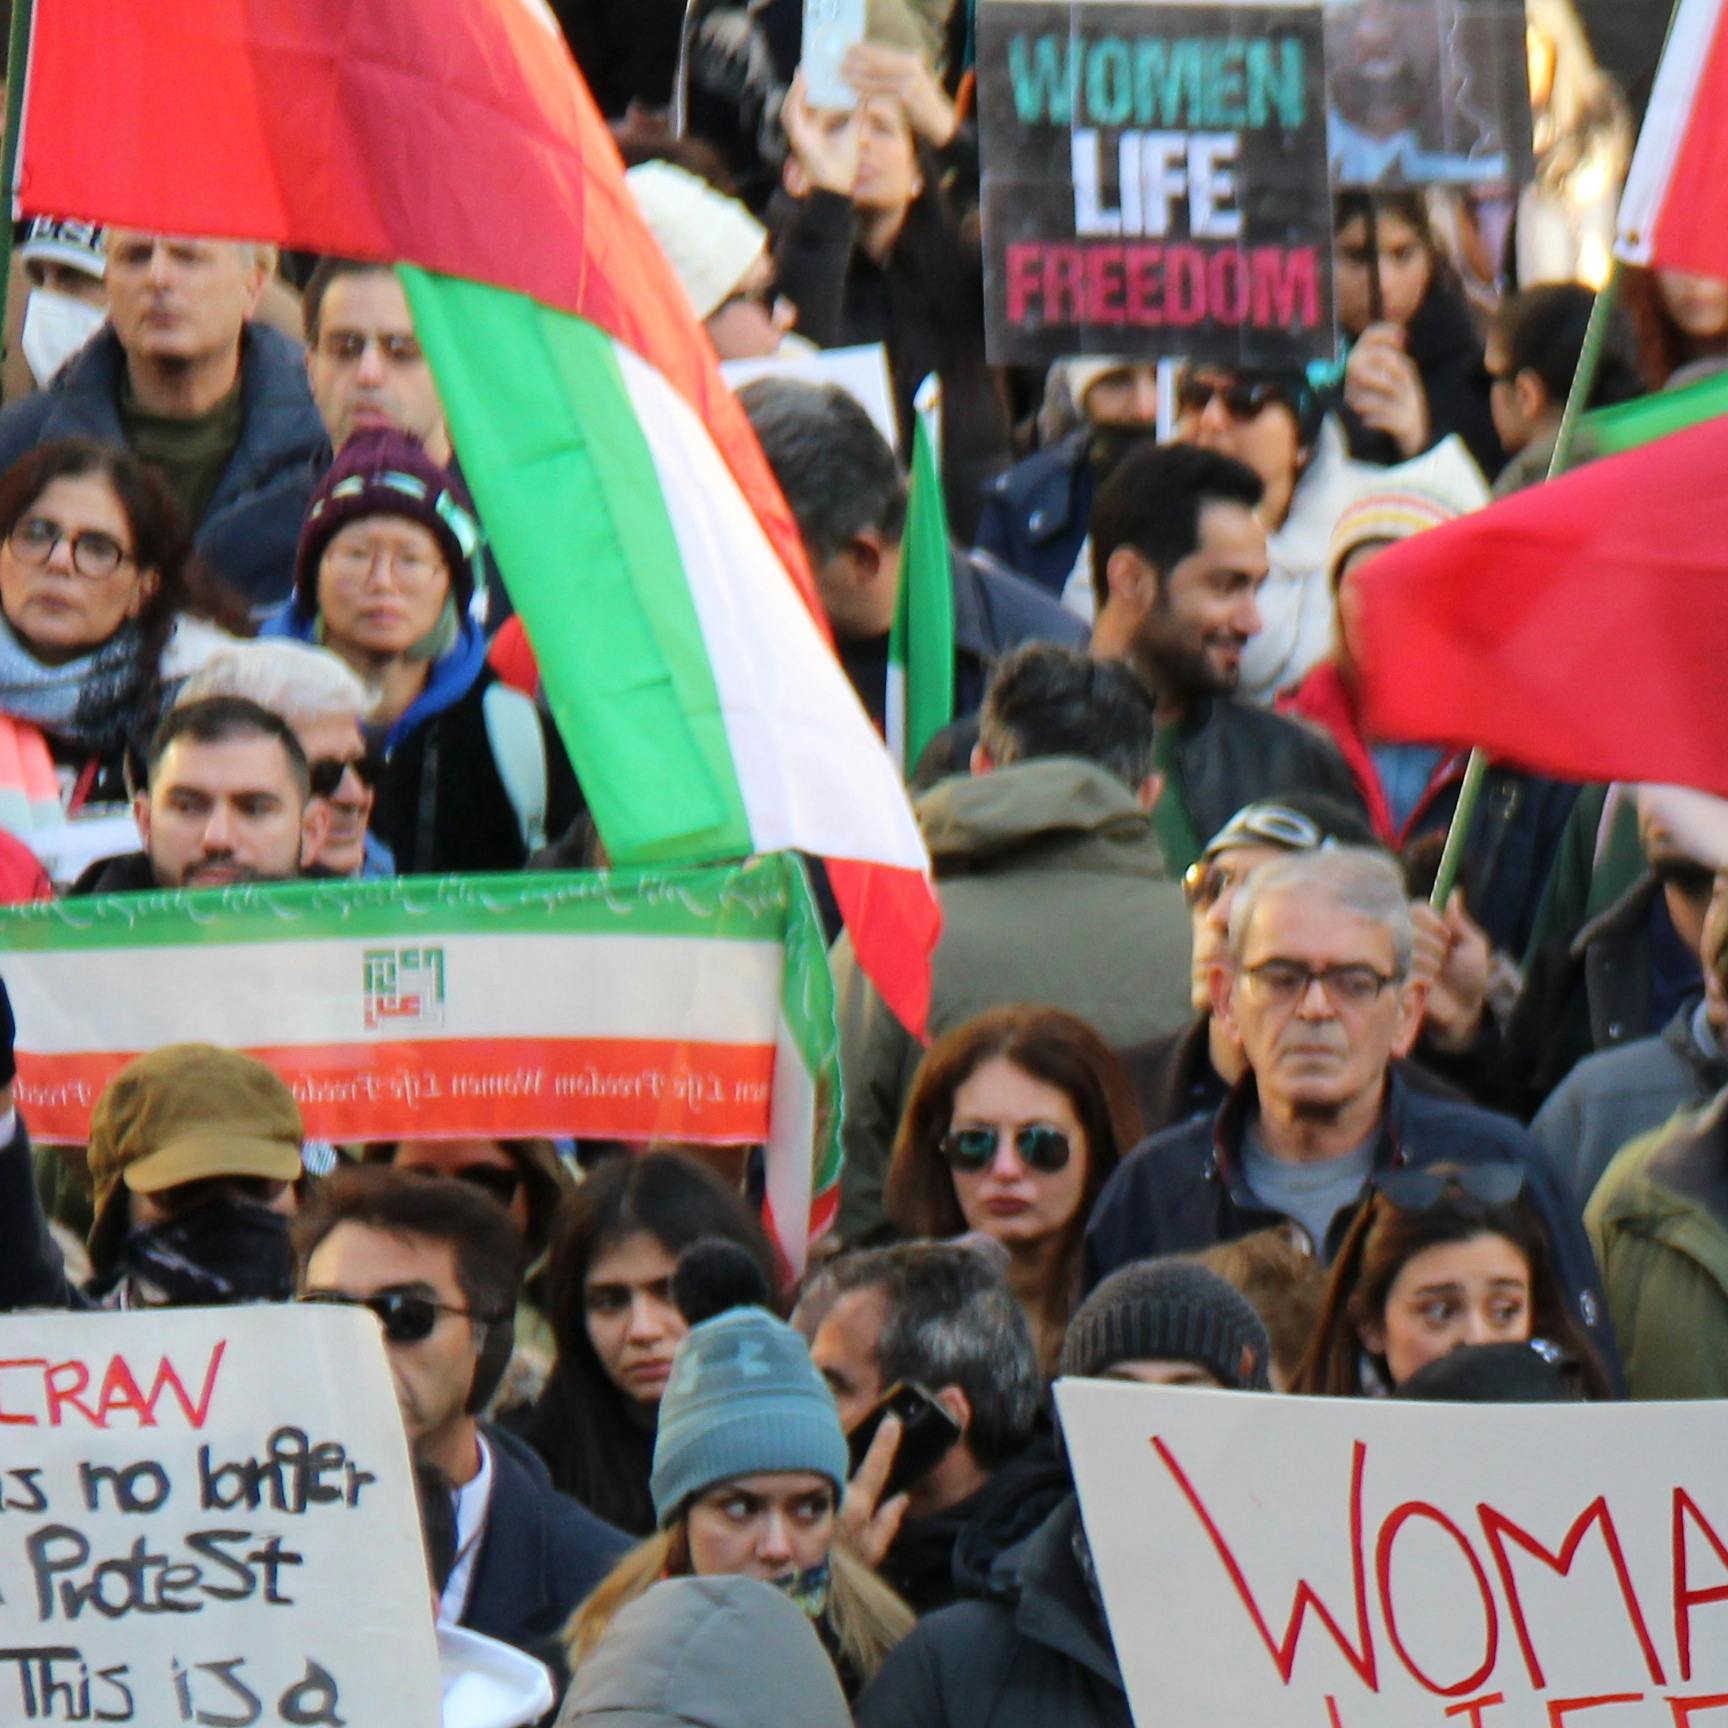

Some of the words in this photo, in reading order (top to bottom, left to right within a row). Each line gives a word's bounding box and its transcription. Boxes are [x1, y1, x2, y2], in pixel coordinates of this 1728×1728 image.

[1009, 35, 1304, 129] WOMEN
[1072, 128, 1243, 239] LIFE
[1005, 244, 1319, 328] FREEDOM
[0, 1339, 227, 1429] IRAN
[0, 1466, 48, 1513] s
[79, 1458, 171, 1513] no
[198, 1425, 378, 1515] longer
[0, 1644, 135, 1724] This
[277, 1655, 346, 1728] a
